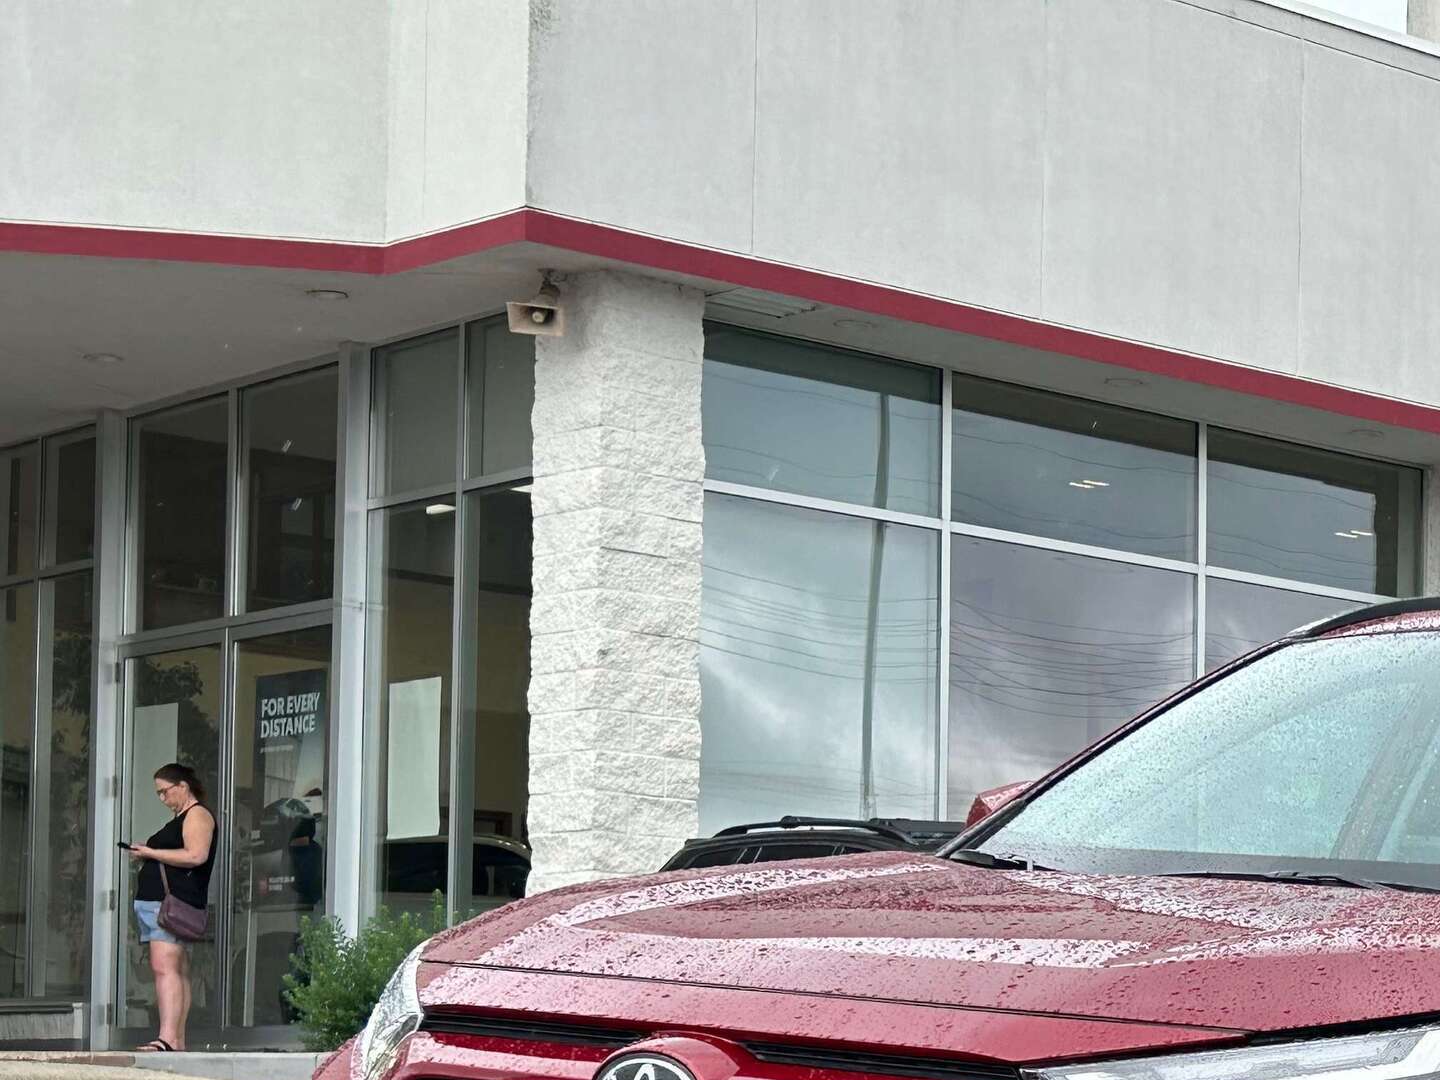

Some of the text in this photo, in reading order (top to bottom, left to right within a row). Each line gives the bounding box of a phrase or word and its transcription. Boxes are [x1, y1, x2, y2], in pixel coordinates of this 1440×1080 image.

[261, 692, 320, 718] FOR EVERY
[260, 713, 316, 739] DISTANCE
